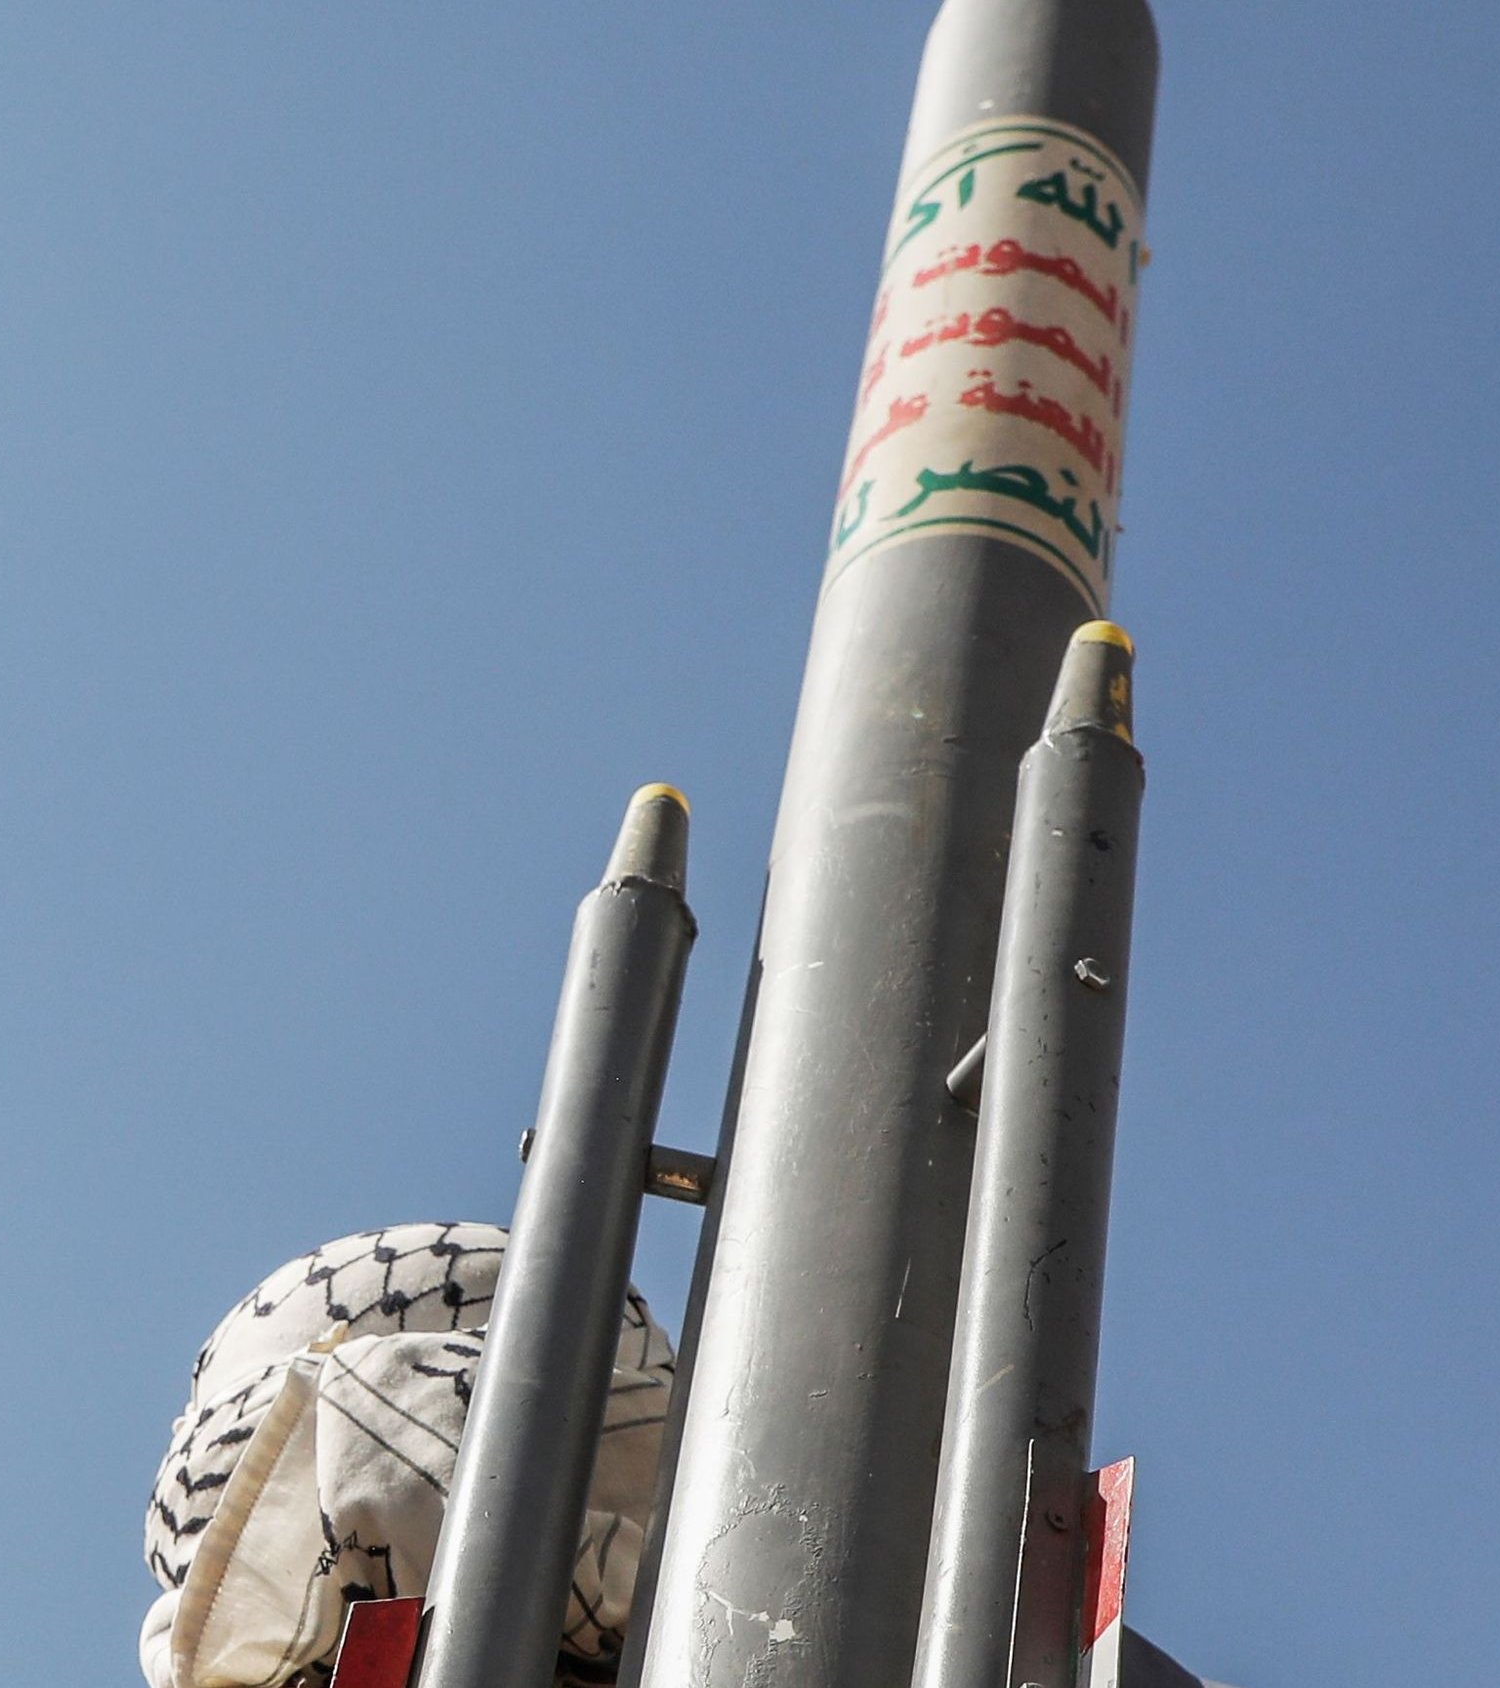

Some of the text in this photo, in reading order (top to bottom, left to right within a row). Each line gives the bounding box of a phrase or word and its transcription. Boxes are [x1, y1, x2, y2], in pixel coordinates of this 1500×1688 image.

[911, 239, 1129, 348] الموت
[899, 307, 1122, 419] الموت
[958, 369, 1114, 496] اللعنة
[877, 460, 1110, 582] النصر
